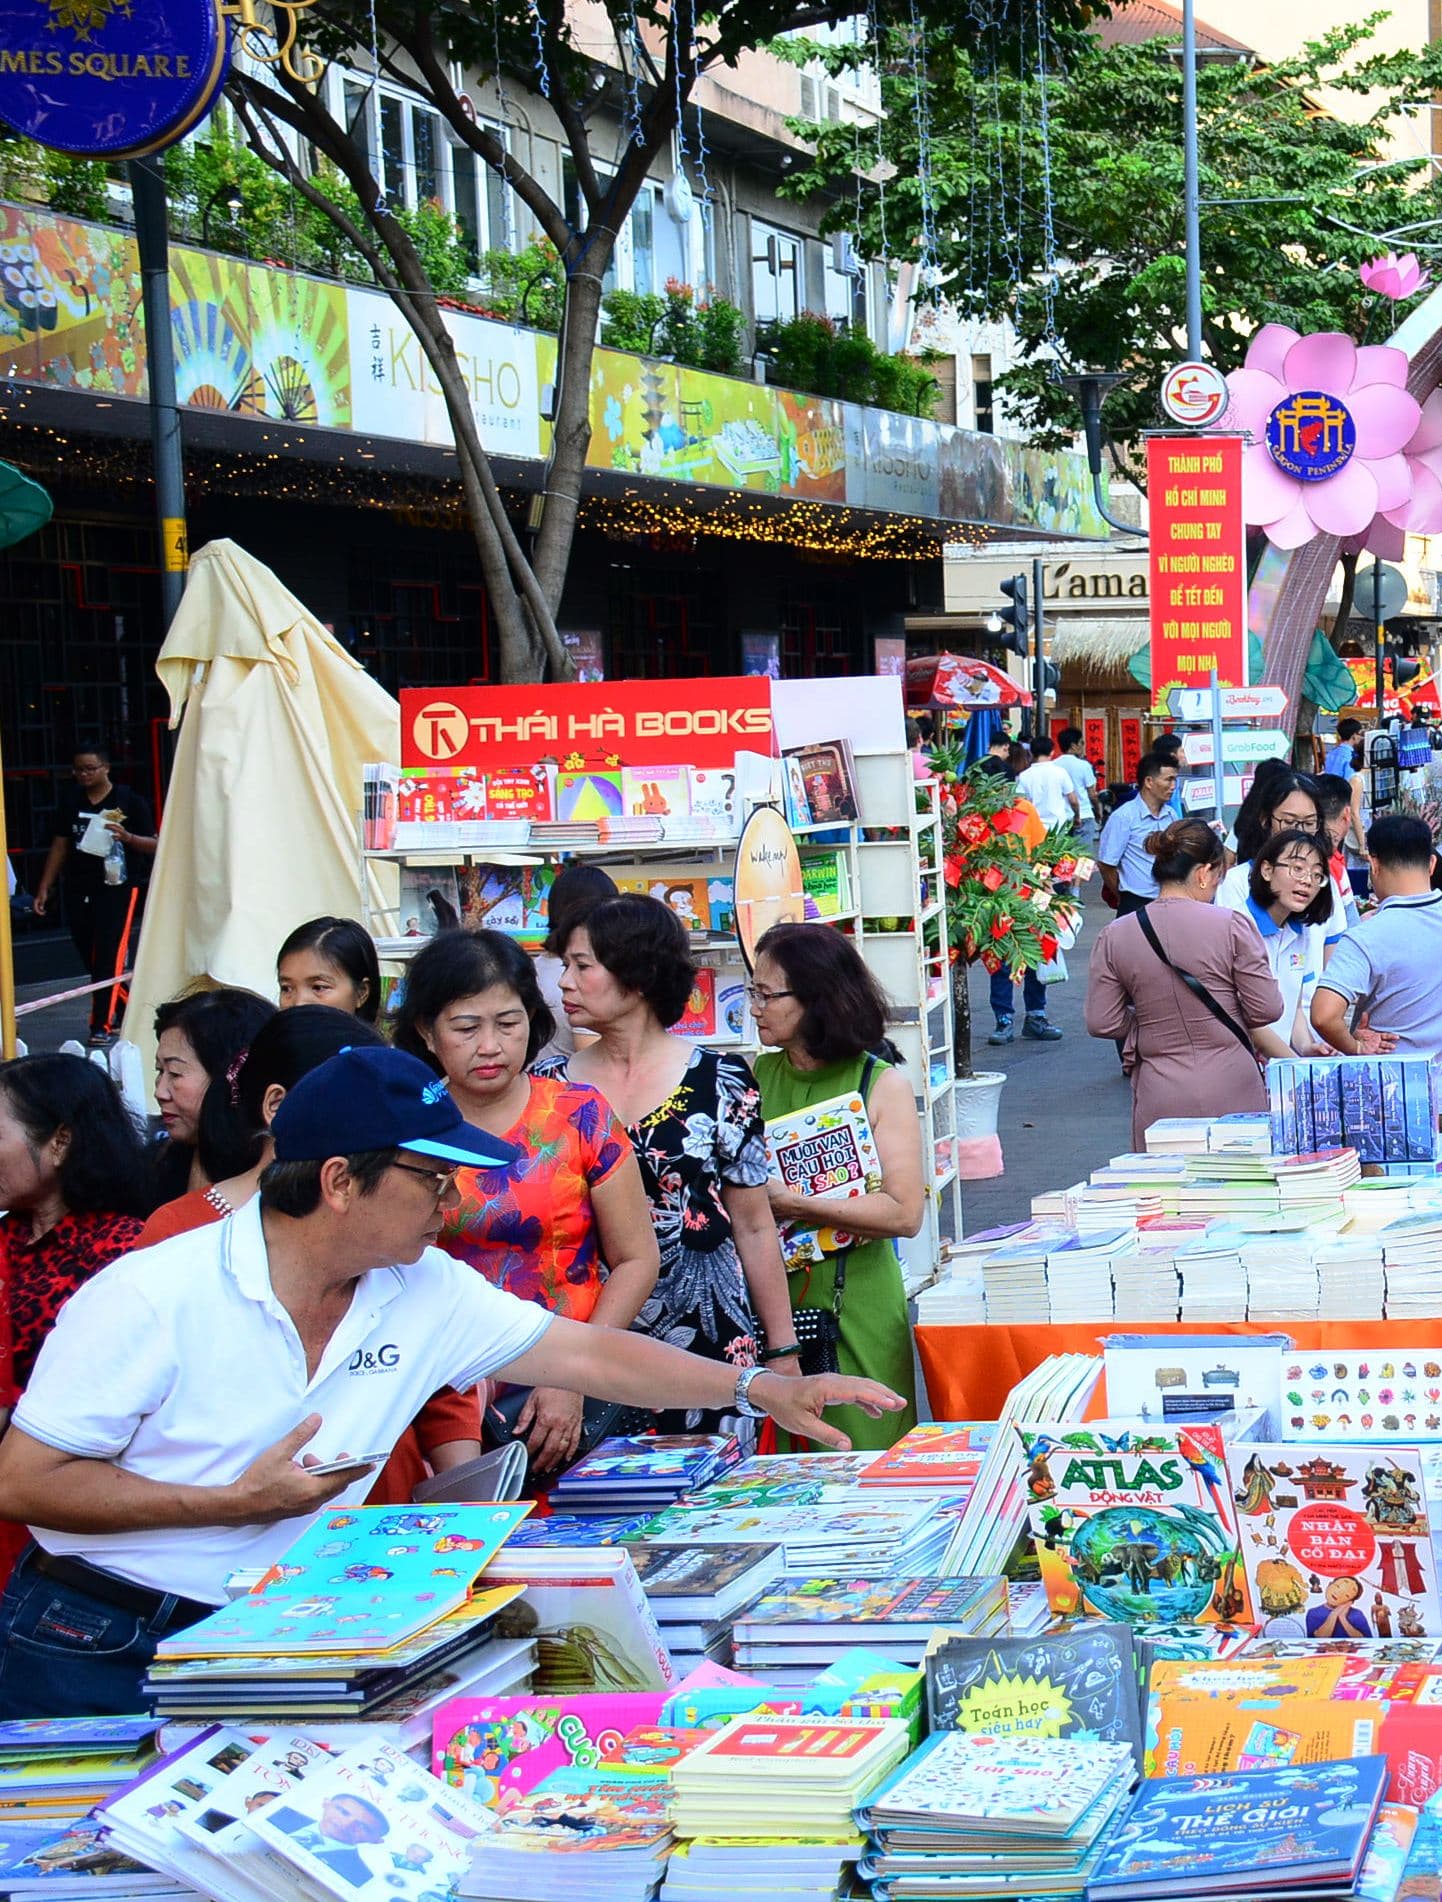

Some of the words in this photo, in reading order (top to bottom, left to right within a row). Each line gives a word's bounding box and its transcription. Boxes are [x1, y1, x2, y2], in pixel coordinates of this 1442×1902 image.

[69, 52, 192, 81] SQUARE
[1168, 454, 1200, 473] THÀNH
[1202, 453, 1223, 473] PHỐ
[1165, 485, 1179, 506] HỒ
[1181, 485, 1198, 506] CHÍ
[1200, 489, 1226, 506] MINH
[1170, 523, 1203, 539] CHUNG
[1205, 522, 1222, 539] TAY
[470, 710, 558, 742] THÁI
[568, 707, 625, 739] HÀ
[635, 708, 771, 737] BOOKS
[1061, 1458, 1184, 1491] ATLAS
[1089, 1491, 1133, 1505] ĐỘNG
[1135, 1491, 1163, 1504] VẬT
[1301, 1520, 1357, 1534] NHẬT
[1310, 1533, 1352, 1546] BẢN
[1328, 1549, 1367, 1562] ĐẠI
[970, 1700, 1015, 1724] Toán
[1018, 1698, 1049, 1718] học
[1014, 1716, 1044, 1733] hay
